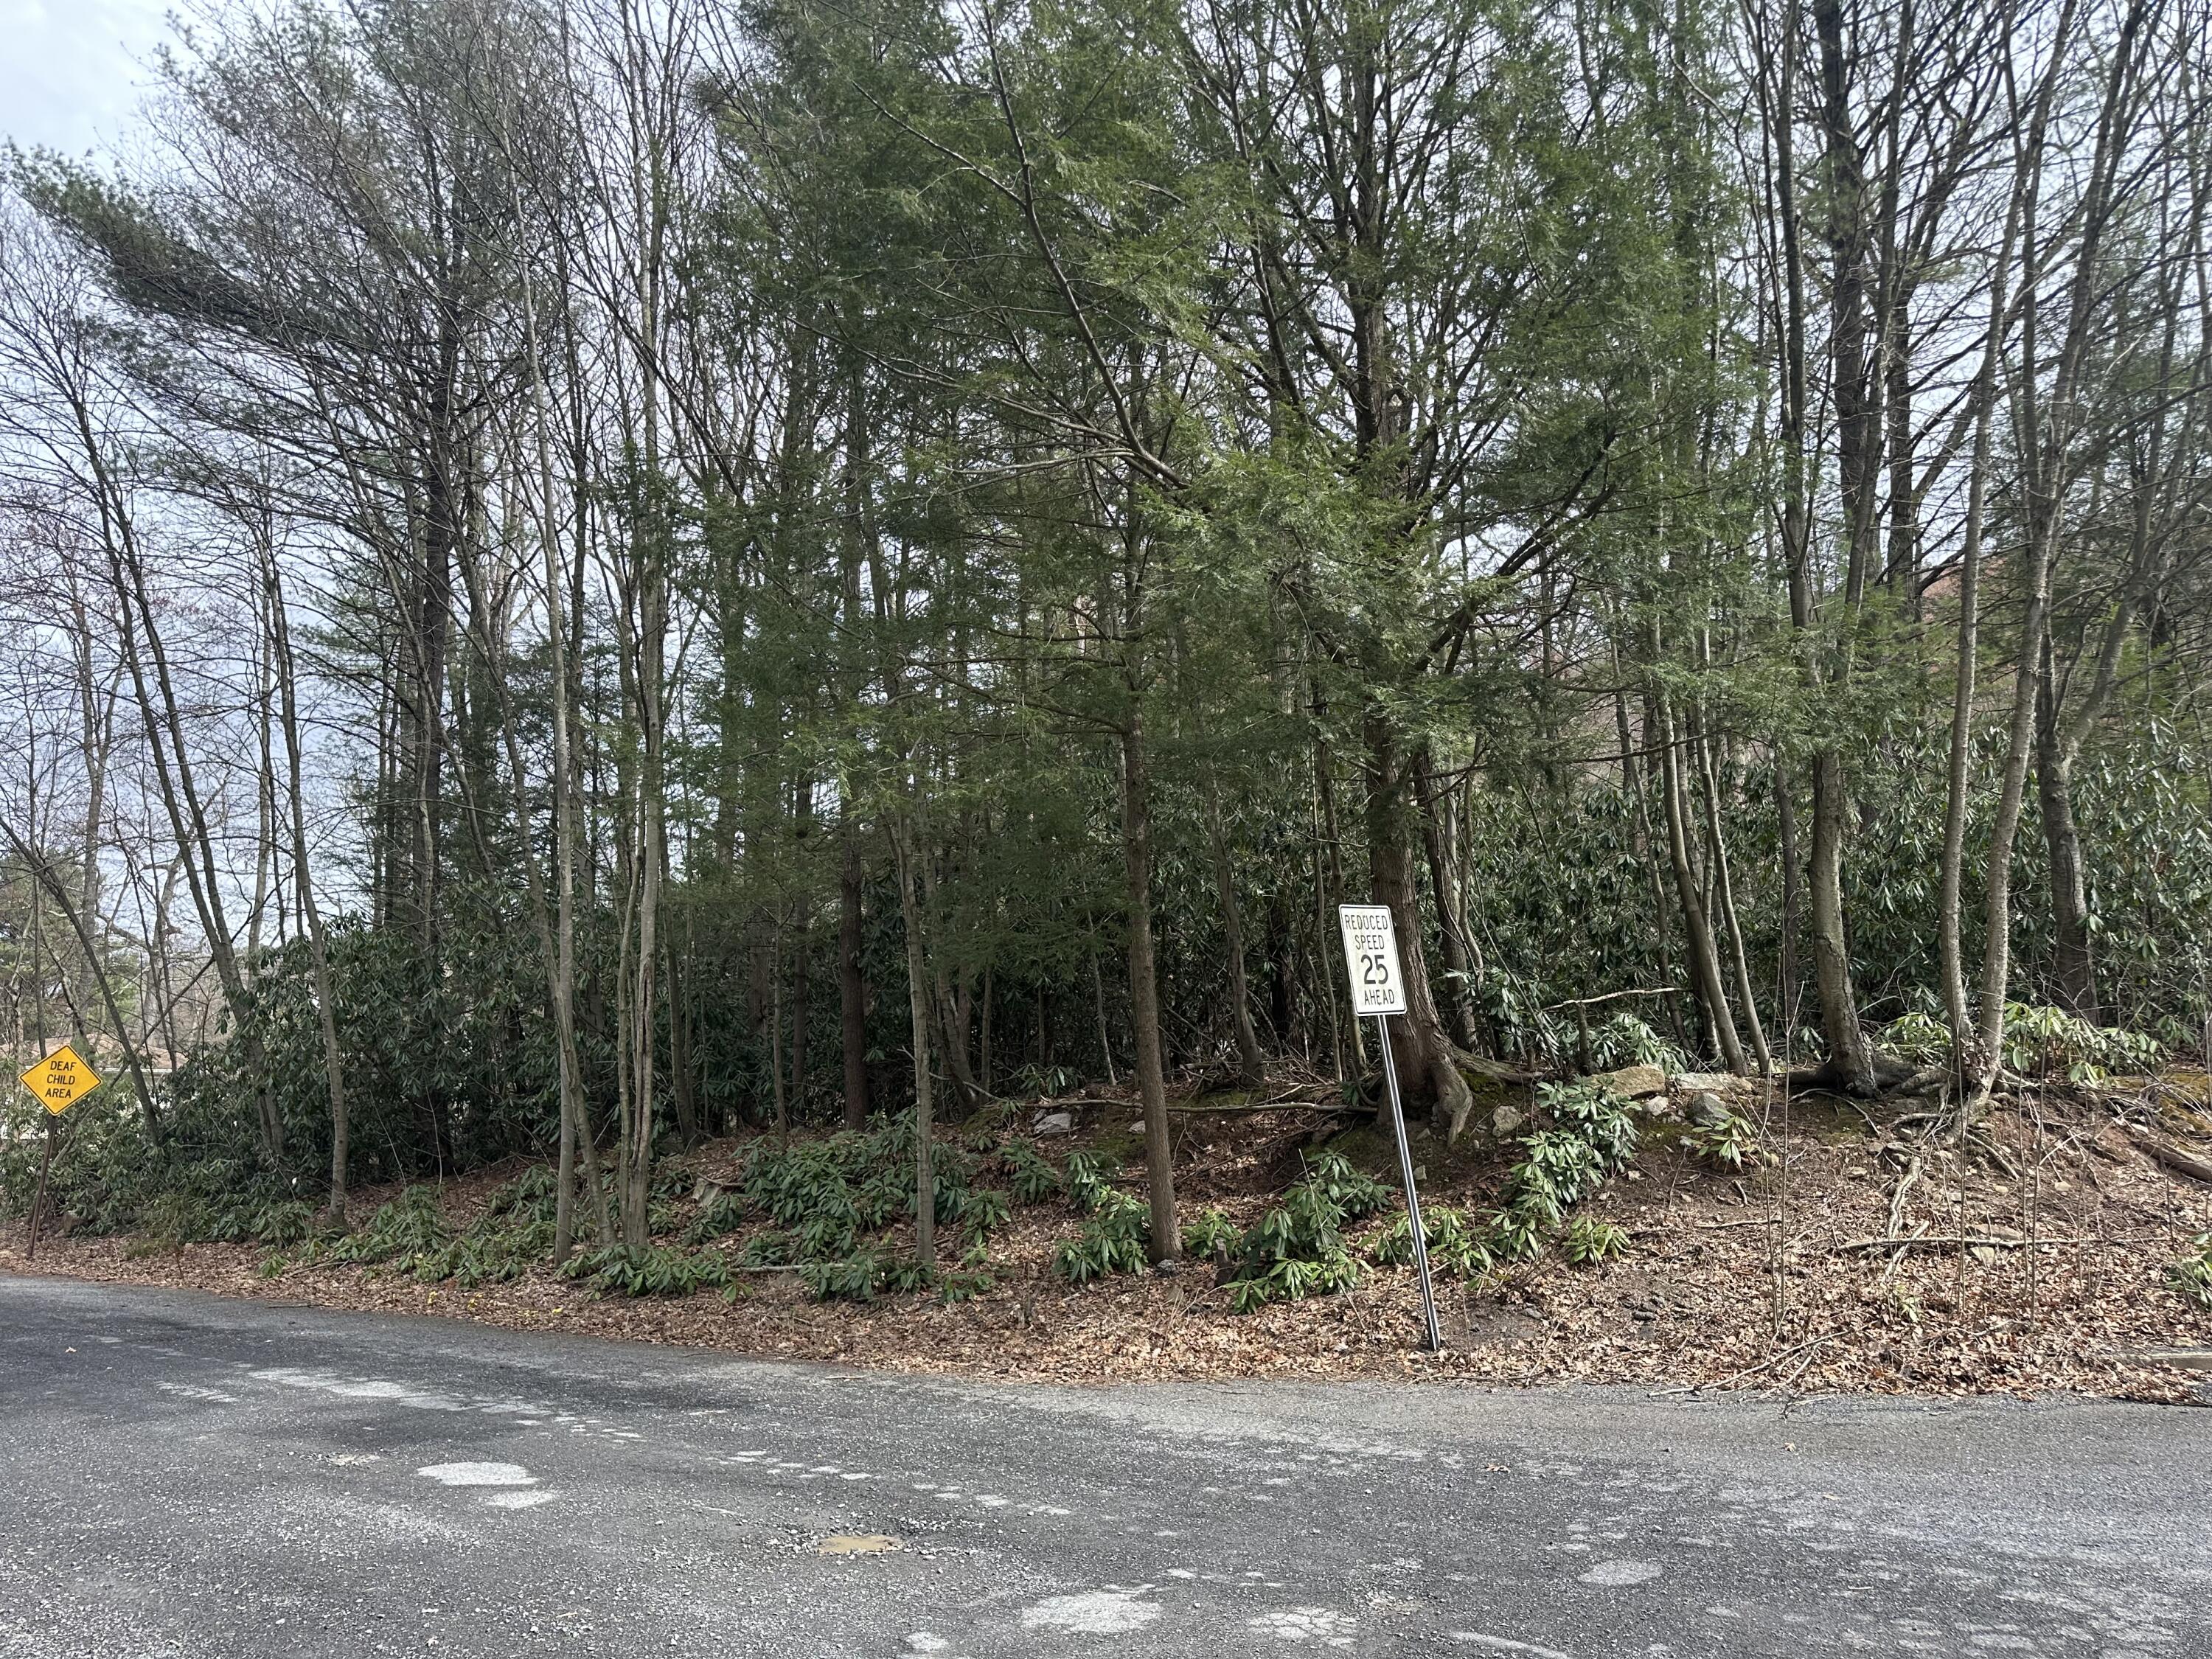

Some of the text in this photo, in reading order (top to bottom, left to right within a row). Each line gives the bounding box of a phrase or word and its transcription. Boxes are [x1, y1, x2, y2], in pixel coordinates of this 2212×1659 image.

[1344, 915, 1388, 930] REDUCED
[1354, 935, 1385, 950] SPEED
[1360, 954, 1388, 984] 25
[1364, 990, 1394, 1005] AHEAD
[50, 1061, 77, 1071] DEAF
[46, 1074, 75, 1085] CHILD
[45, 1088, 72, 1098] AREA
